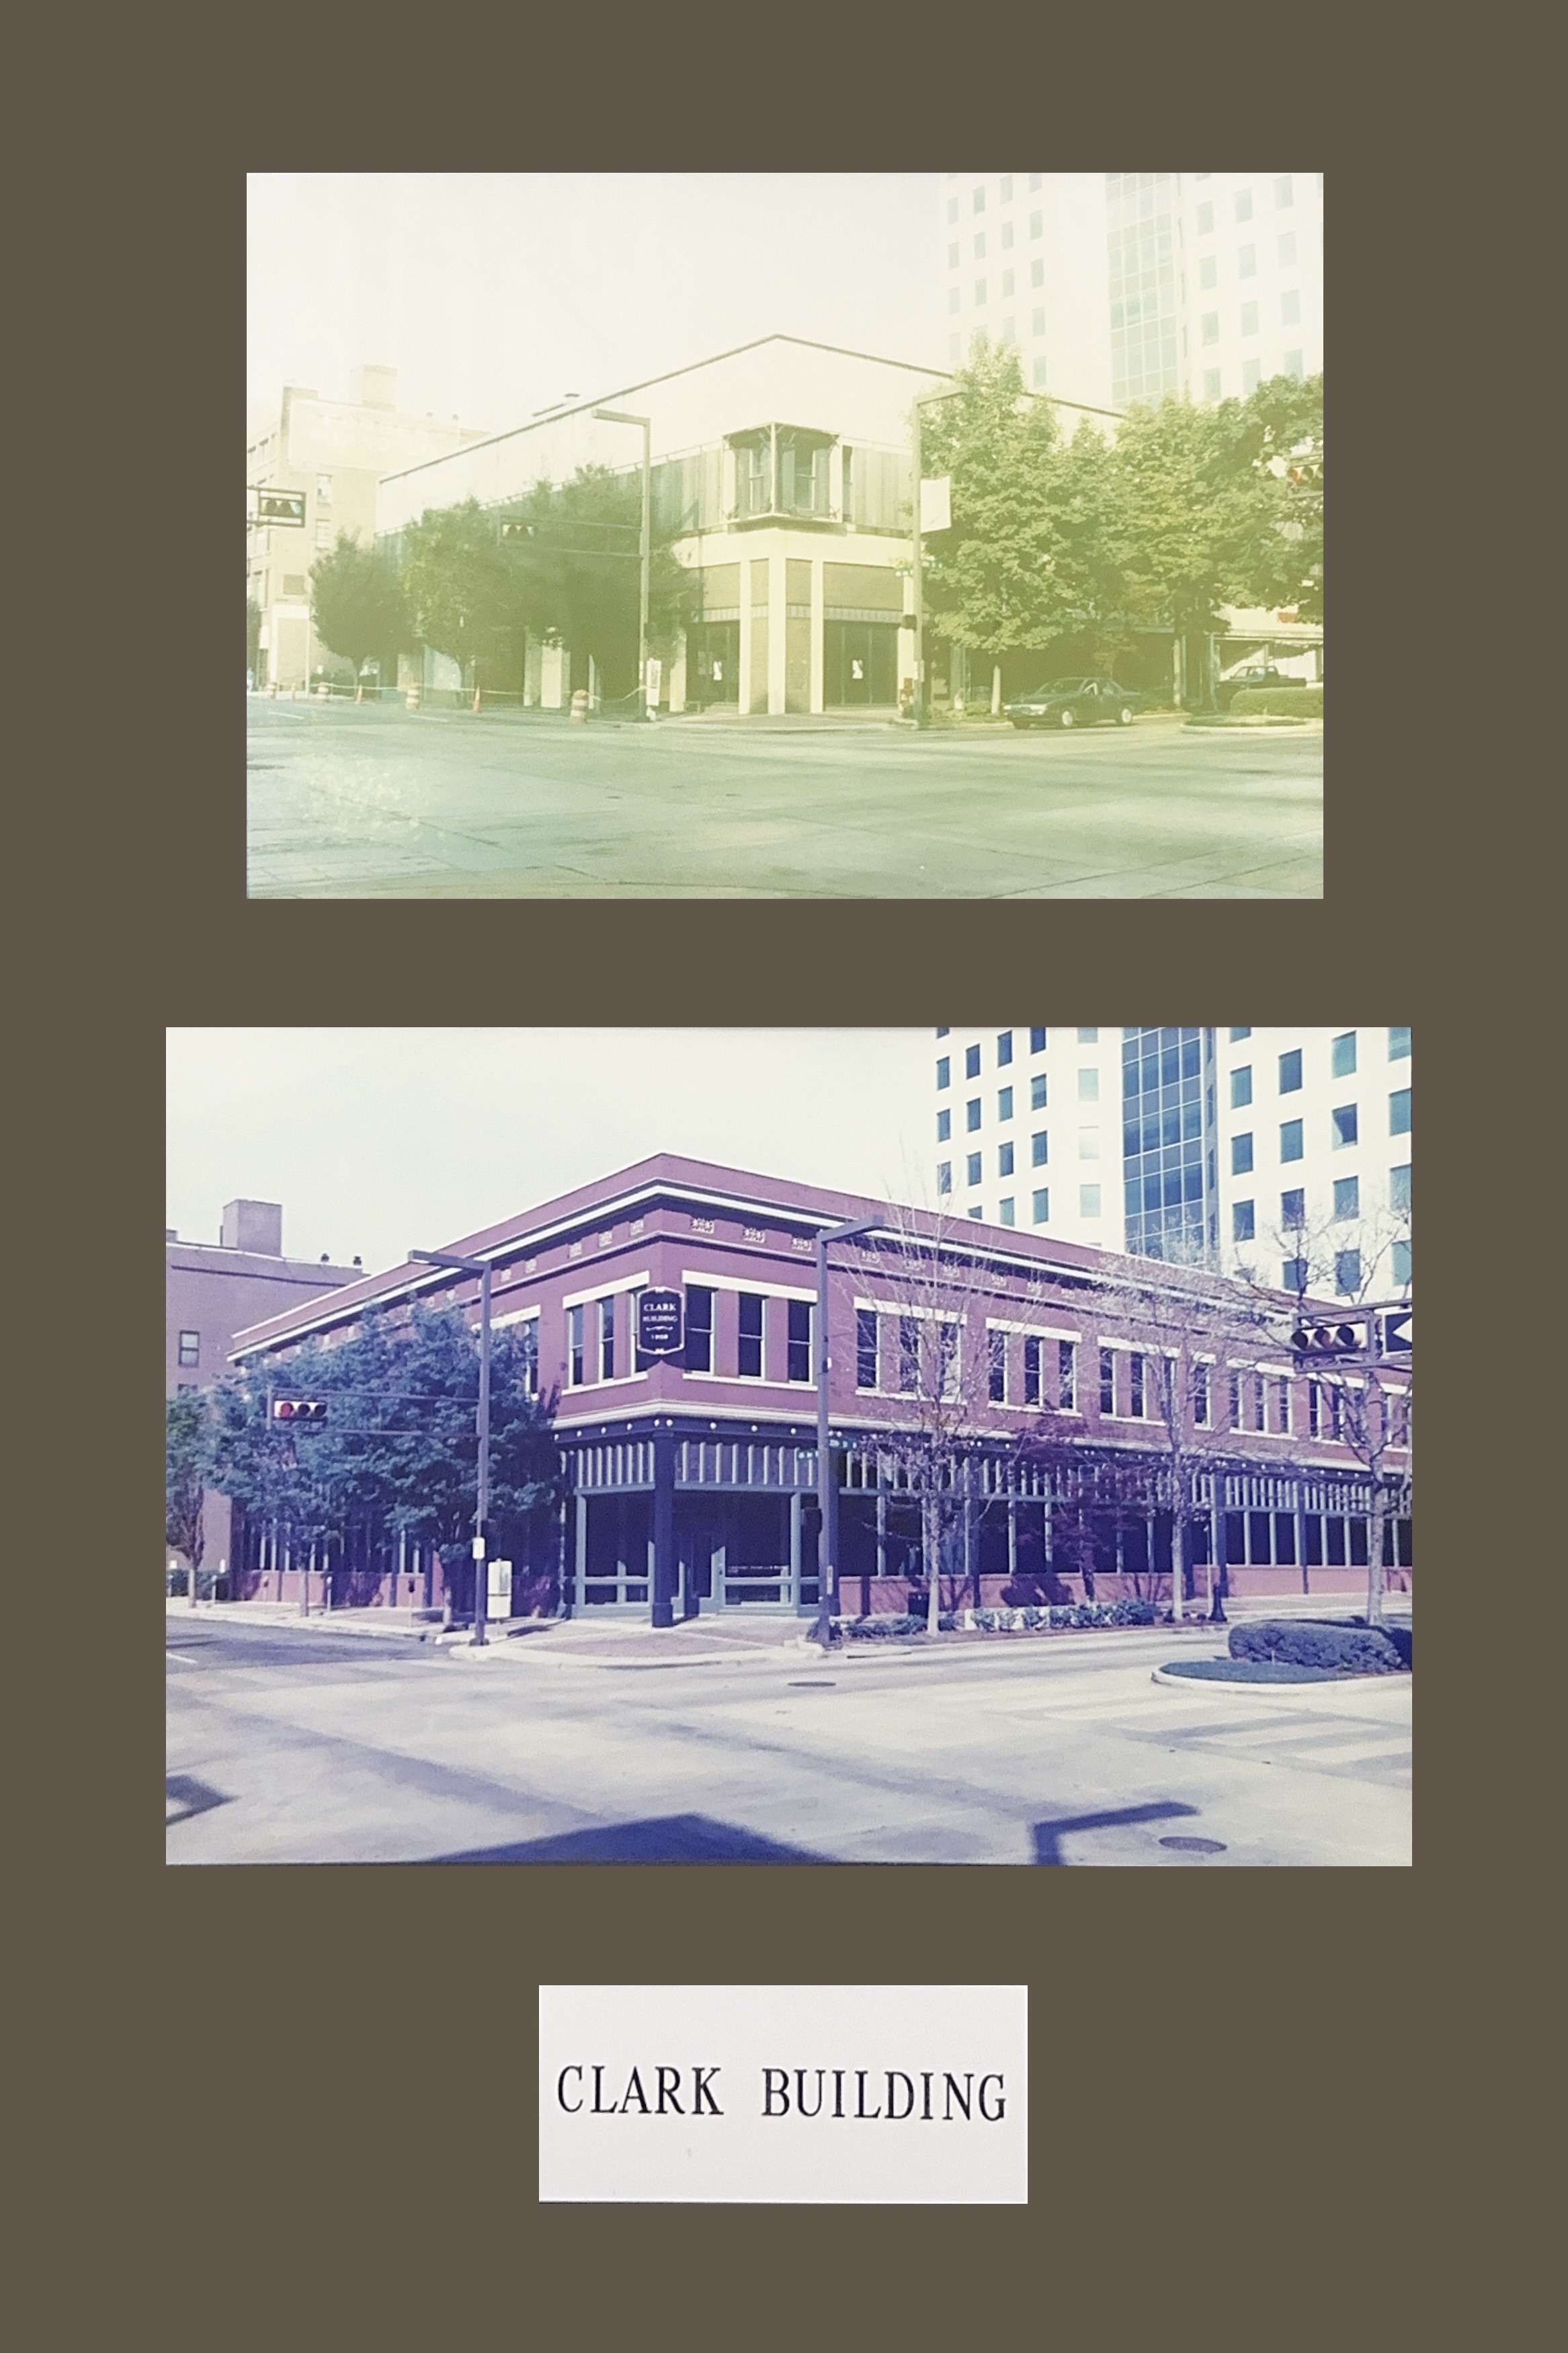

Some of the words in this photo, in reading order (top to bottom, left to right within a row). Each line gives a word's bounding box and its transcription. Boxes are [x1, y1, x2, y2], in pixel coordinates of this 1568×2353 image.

[643, 1303, 677, 1312] CLARK
[557, 2065, 725, 2116] CLARK
[761, 2067, 1006, 2122] BUILDING
